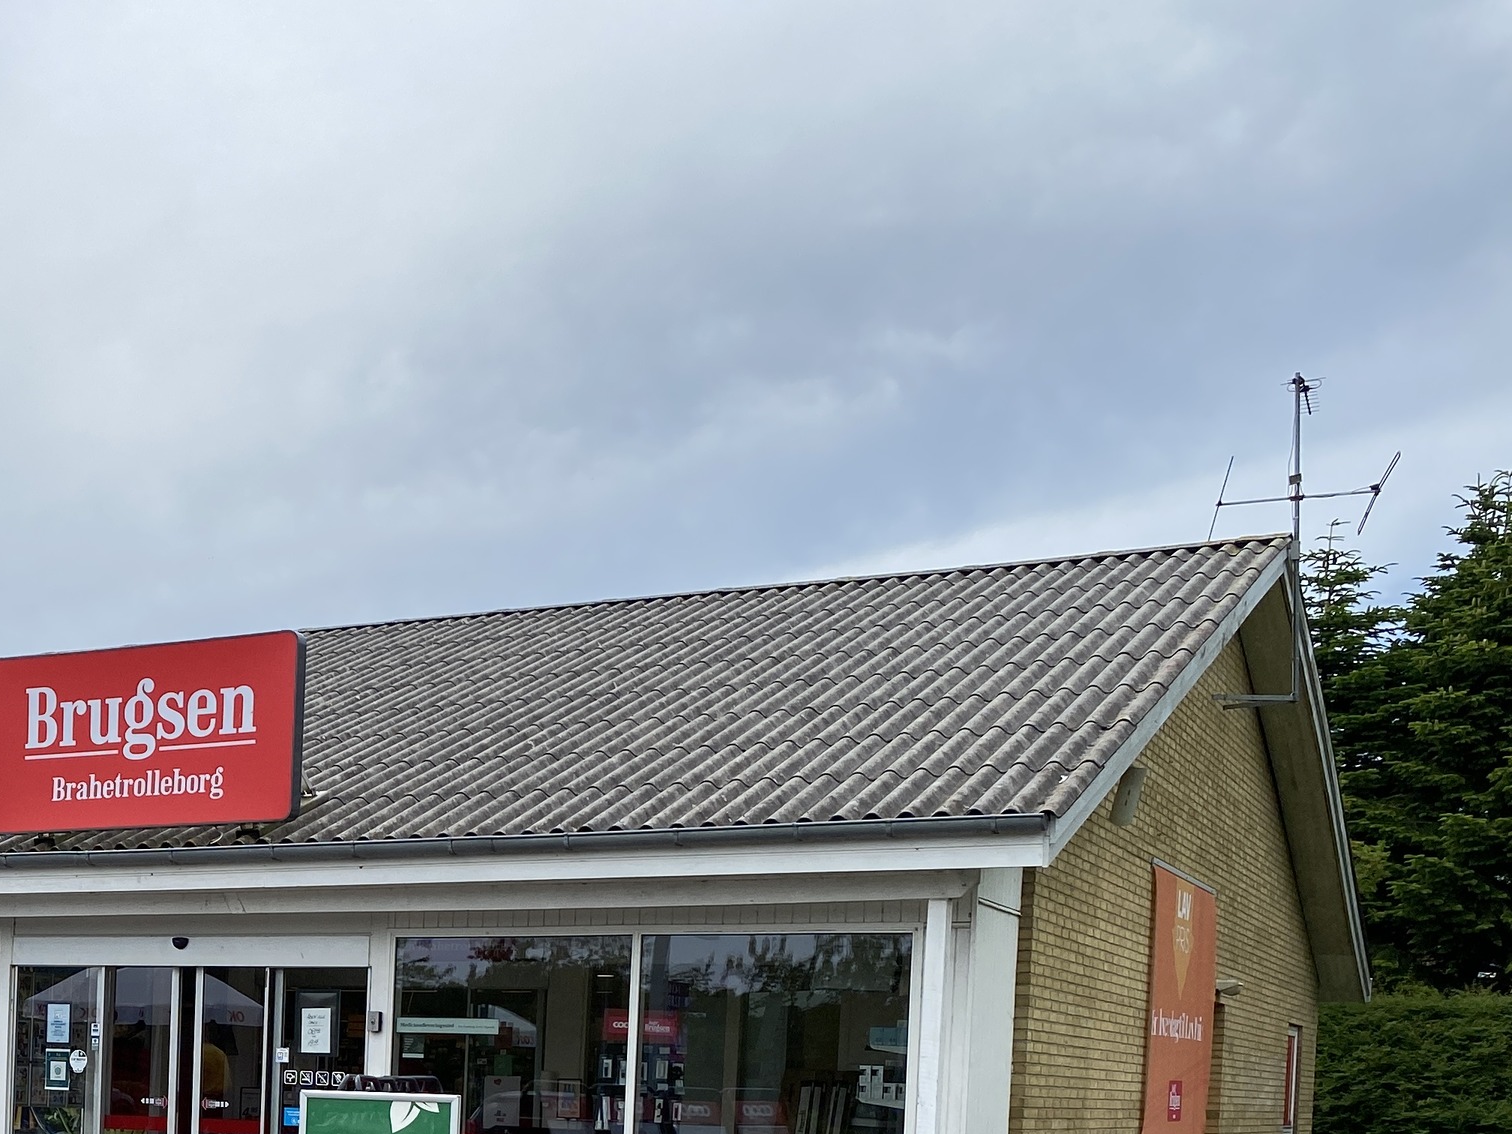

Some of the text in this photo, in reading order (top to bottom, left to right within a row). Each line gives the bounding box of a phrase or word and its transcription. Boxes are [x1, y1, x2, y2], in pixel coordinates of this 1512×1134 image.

[25, 677, 257, 760] Brugsen
[51, 766, 224, 802] Brahetrolleborg
[1177, 890, 1192, 921] LAV
